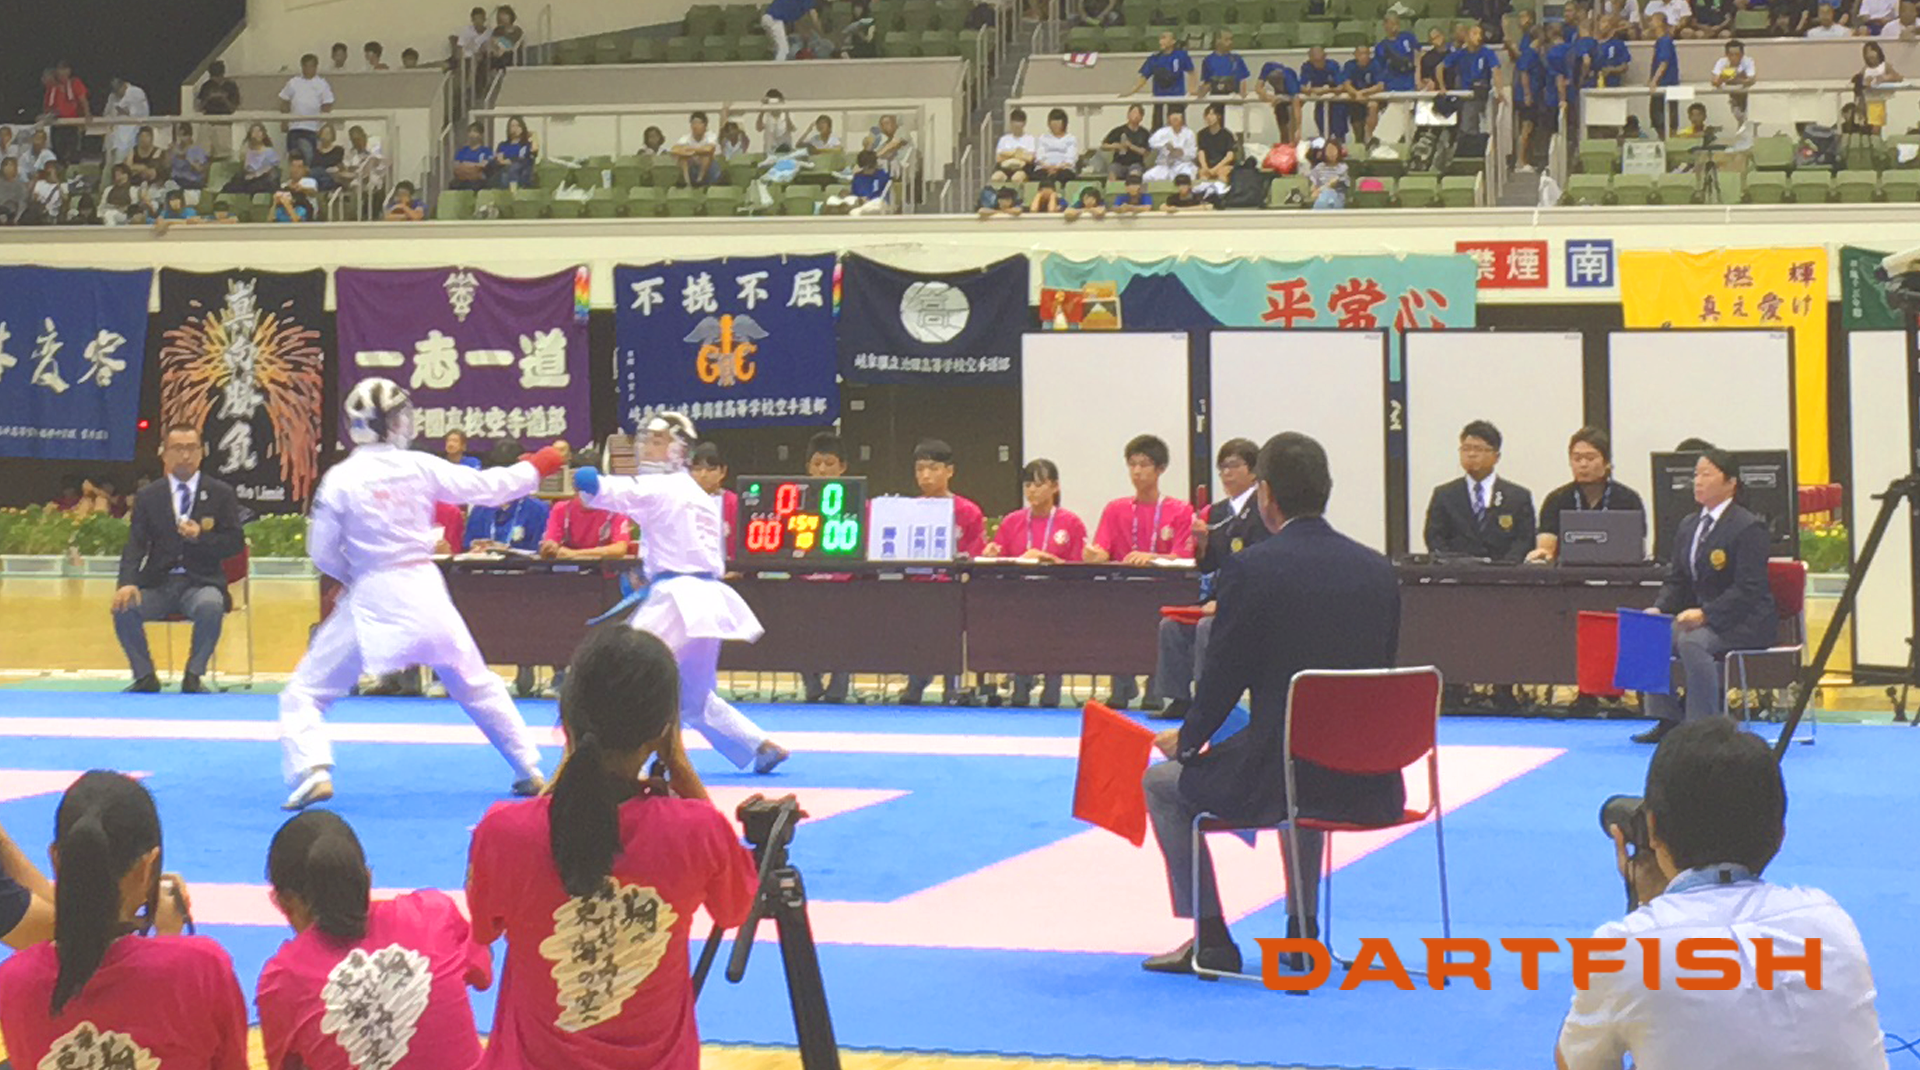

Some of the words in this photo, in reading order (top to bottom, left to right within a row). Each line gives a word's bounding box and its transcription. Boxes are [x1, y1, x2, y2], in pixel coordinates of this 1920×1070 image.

[1568, 243, 1610, 283] 南
[1260, 277, 1448, 332] 平常心
[354, 327, 571, 390] 一志一道
[821, 483, 844, 515] 0
[747, 520, 782, 550] 00
[822, 519, 858, 551] 00
